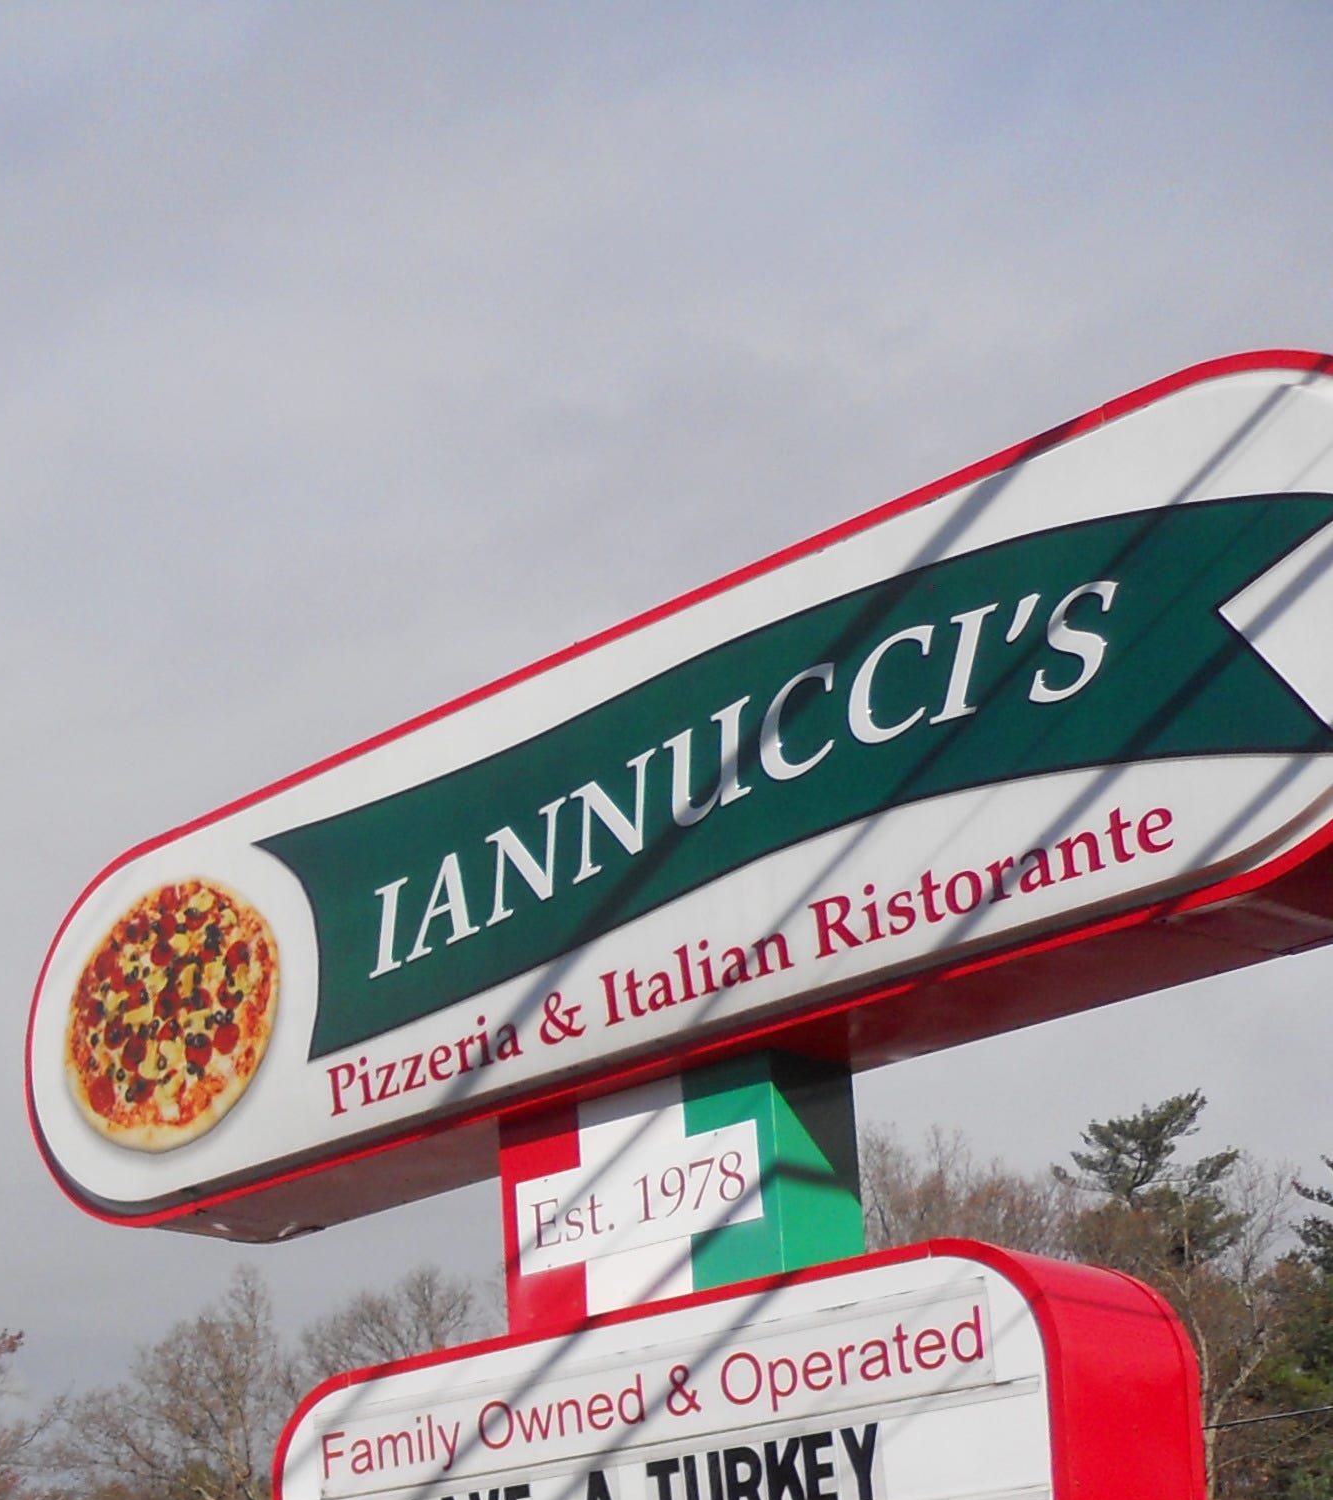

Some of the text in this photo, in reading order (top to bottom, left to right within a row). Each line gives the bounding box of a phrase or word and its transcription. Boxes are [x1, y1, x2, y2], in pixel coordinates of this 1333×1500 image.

[369, 580, 1120, 979] IANNUCCI'S
[326, 804, 1175, 1117] Pizzeria & Italian Ristorante
[530, 1151, 746, 1250] Est. 1978
[320, 1305, 985, 1481] Family Owned & Operated
